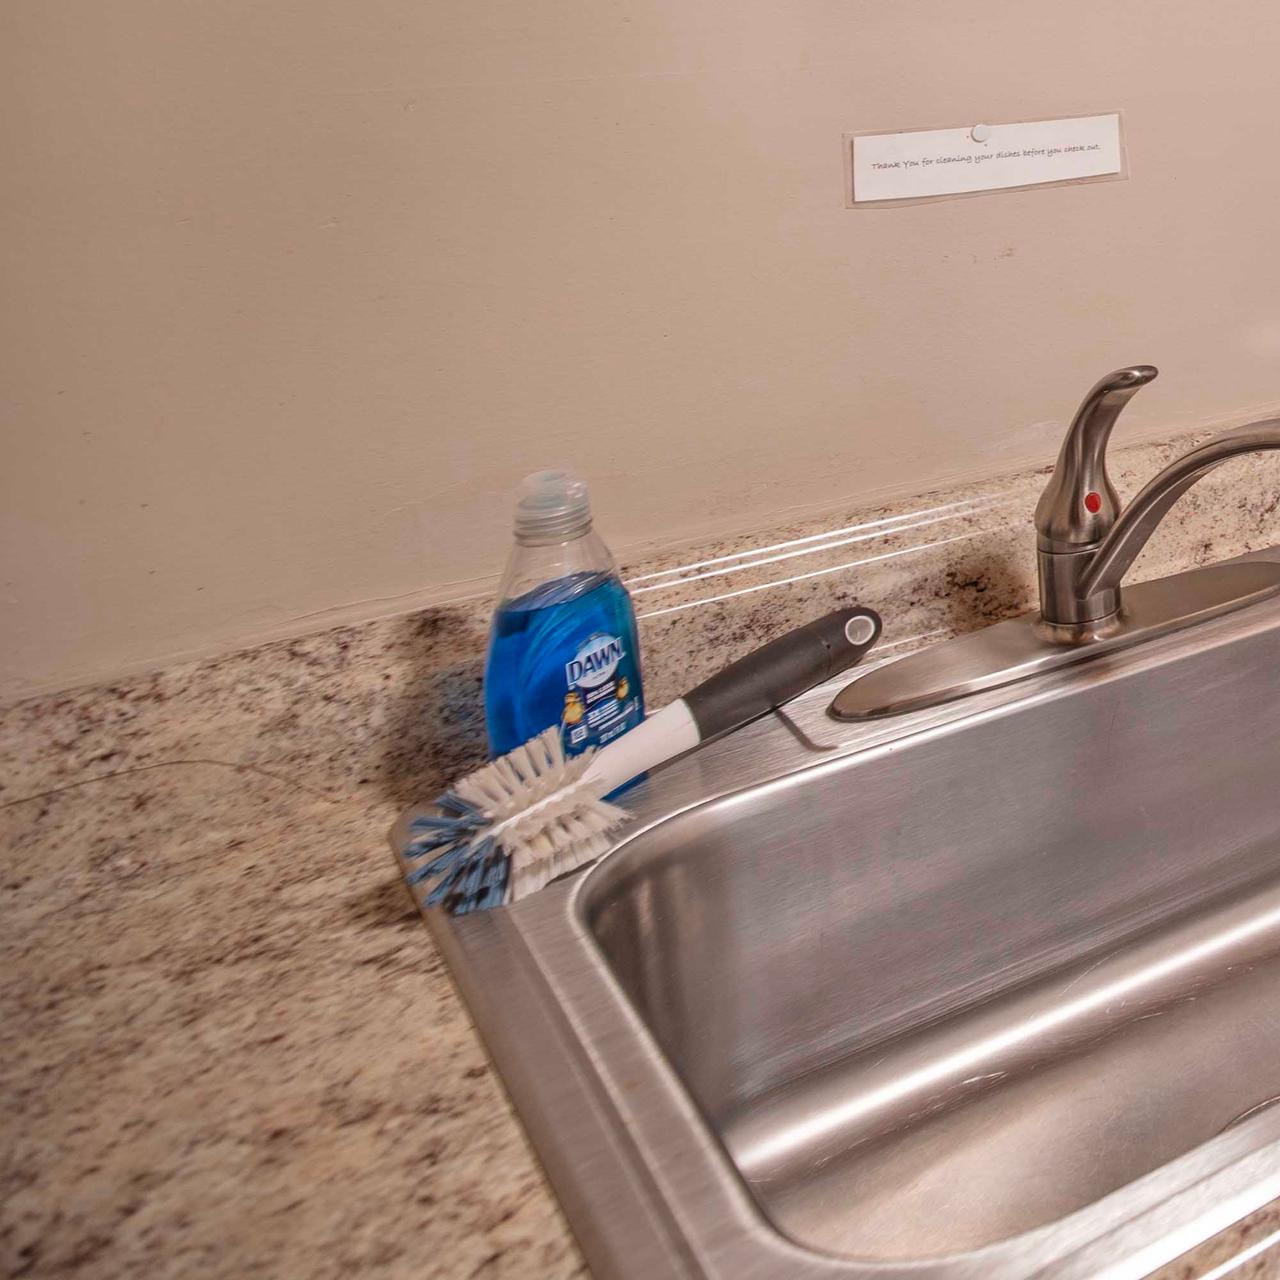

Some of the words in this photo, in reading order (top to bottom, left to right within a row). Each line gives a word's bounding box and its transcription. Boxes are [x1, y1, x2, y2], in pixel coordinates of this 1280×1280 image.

[872, 162, 901, 170] Thank
[922, 157, 934, 167] for
[936, 155, 972, 164] cleaning
[974, 154, 993, 164] your
[996, 151, 1020, 159] dishes
[1023, 148, 1045, 157] before
[1047, 148, 1062, 157] you
[569, 640, 623, 684] DAWN
